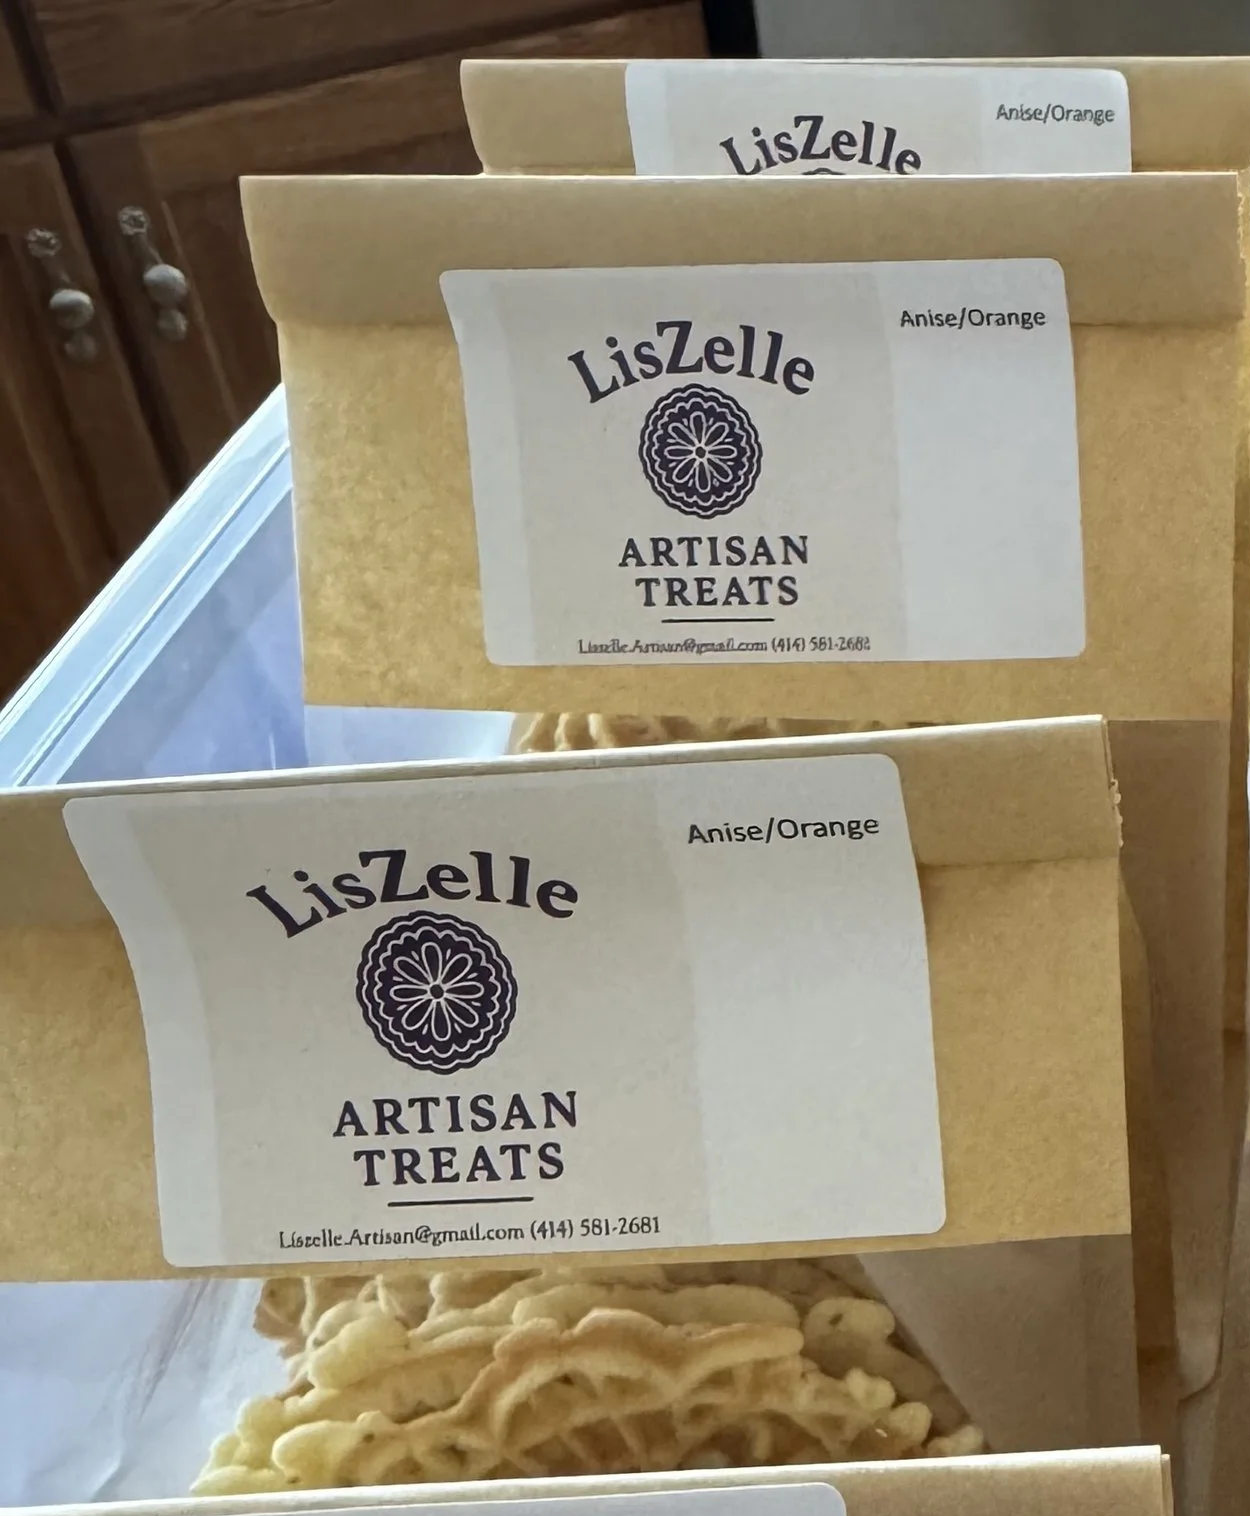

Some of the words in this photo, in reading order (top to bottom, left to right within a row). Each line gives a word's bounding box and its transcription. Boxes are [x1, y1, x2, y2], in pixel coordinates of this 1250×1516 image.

[996, 104, 1115, 125] Anise/Orange
[719, 115, 921, 174] LisZelle
[901, 307, 1045, 330] Anise/Orange
[568, 321, 815, 403] LisZelle
[619, 536, 807, 567] ARTISAN
[635, 576, 798, 607] TREATS
[688, 818, 879, 844] Anise/Orange
[246, 850, 579, 939] LisZelle
[333, 1091, 576, 1137] ARTISAN
[354, 1142, 563, 1186] TREATS
[531, 1219, 573, 1240] (414)
[581, 1217, 659, 1236] 581-2681
